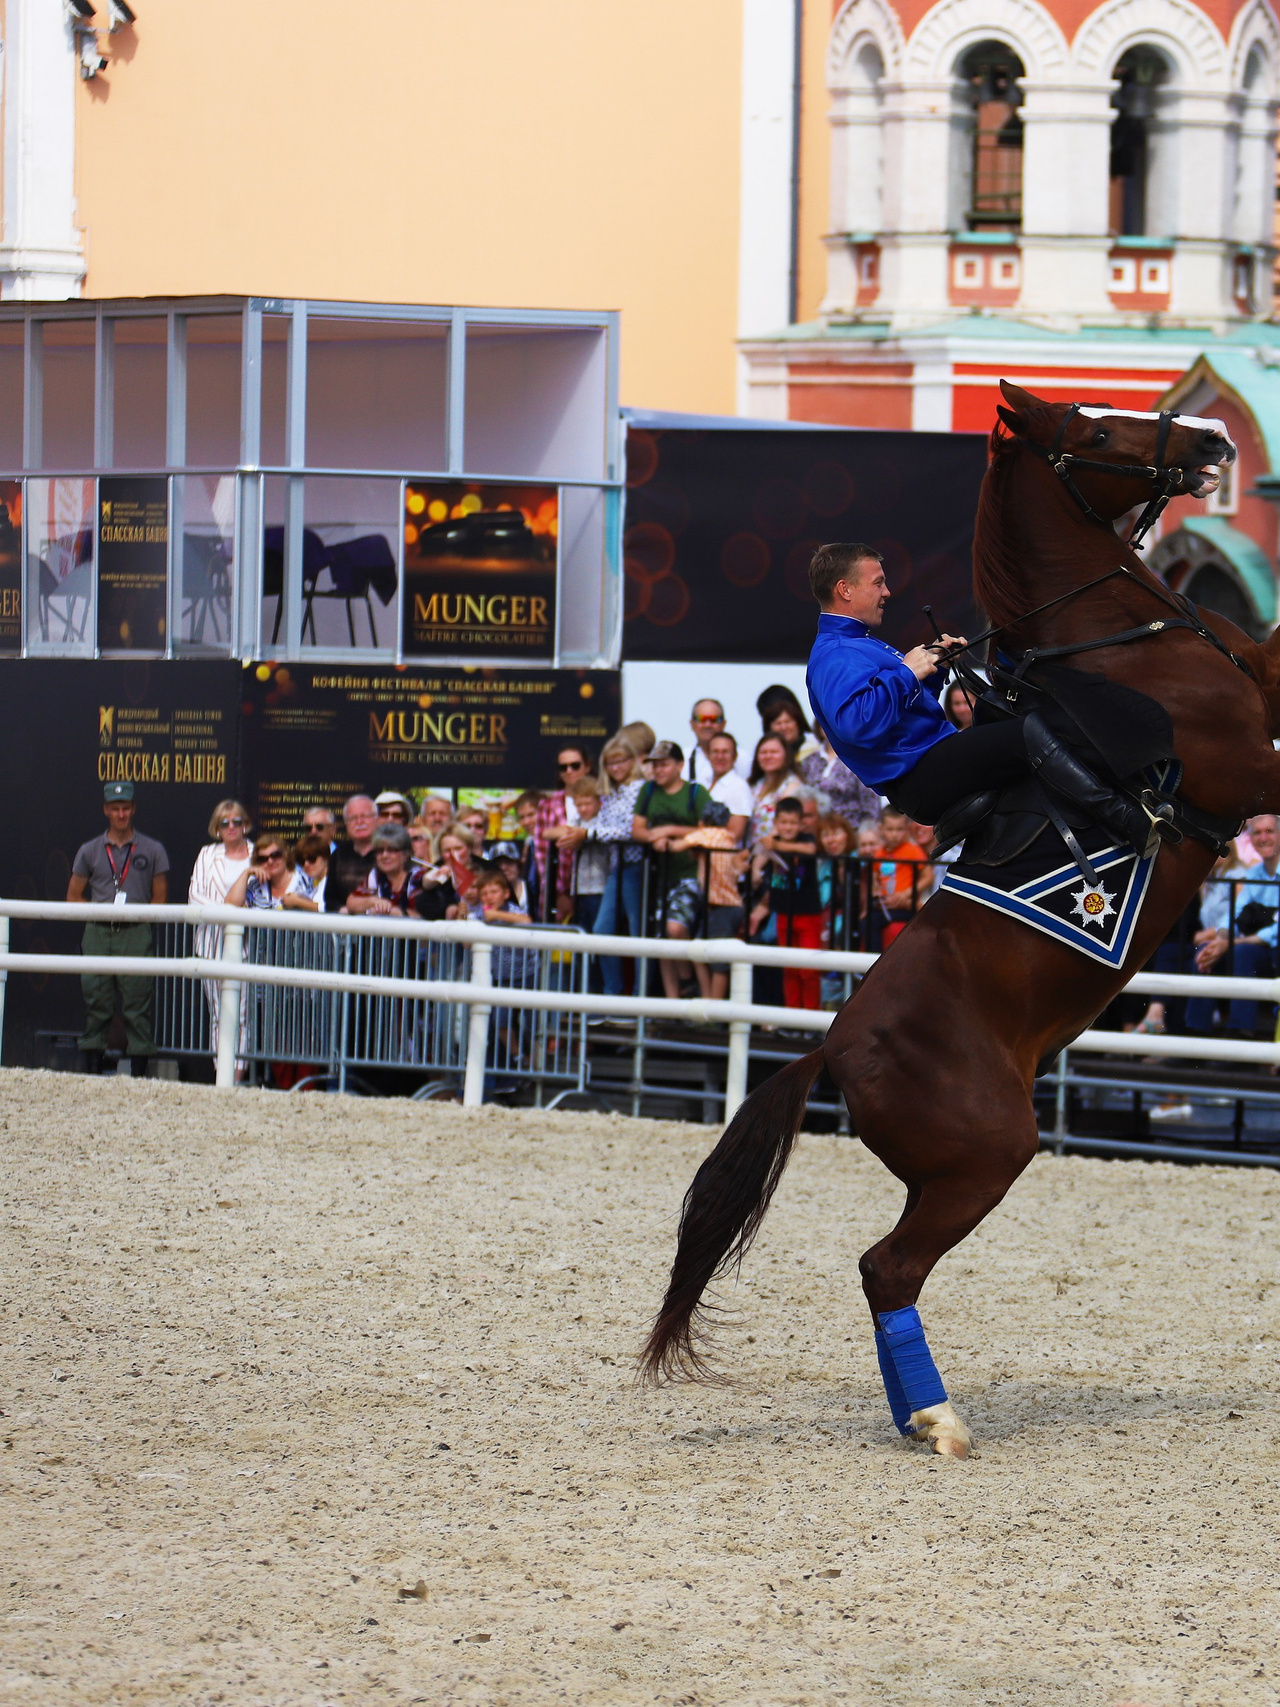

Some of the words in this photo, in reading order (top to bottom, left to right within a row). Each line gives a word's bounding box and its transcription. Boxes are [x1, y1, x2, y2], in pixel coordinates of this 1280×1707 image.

[413, 592, 548, 625] MUNGER
[460, 630, 546, 645] CHOCOLATIER
[369, 710, 508, 744] MUNGER
[98, 751, 170, 782] СПАССКАЯ
[174, 753, 226, 784] БАШНЯ
